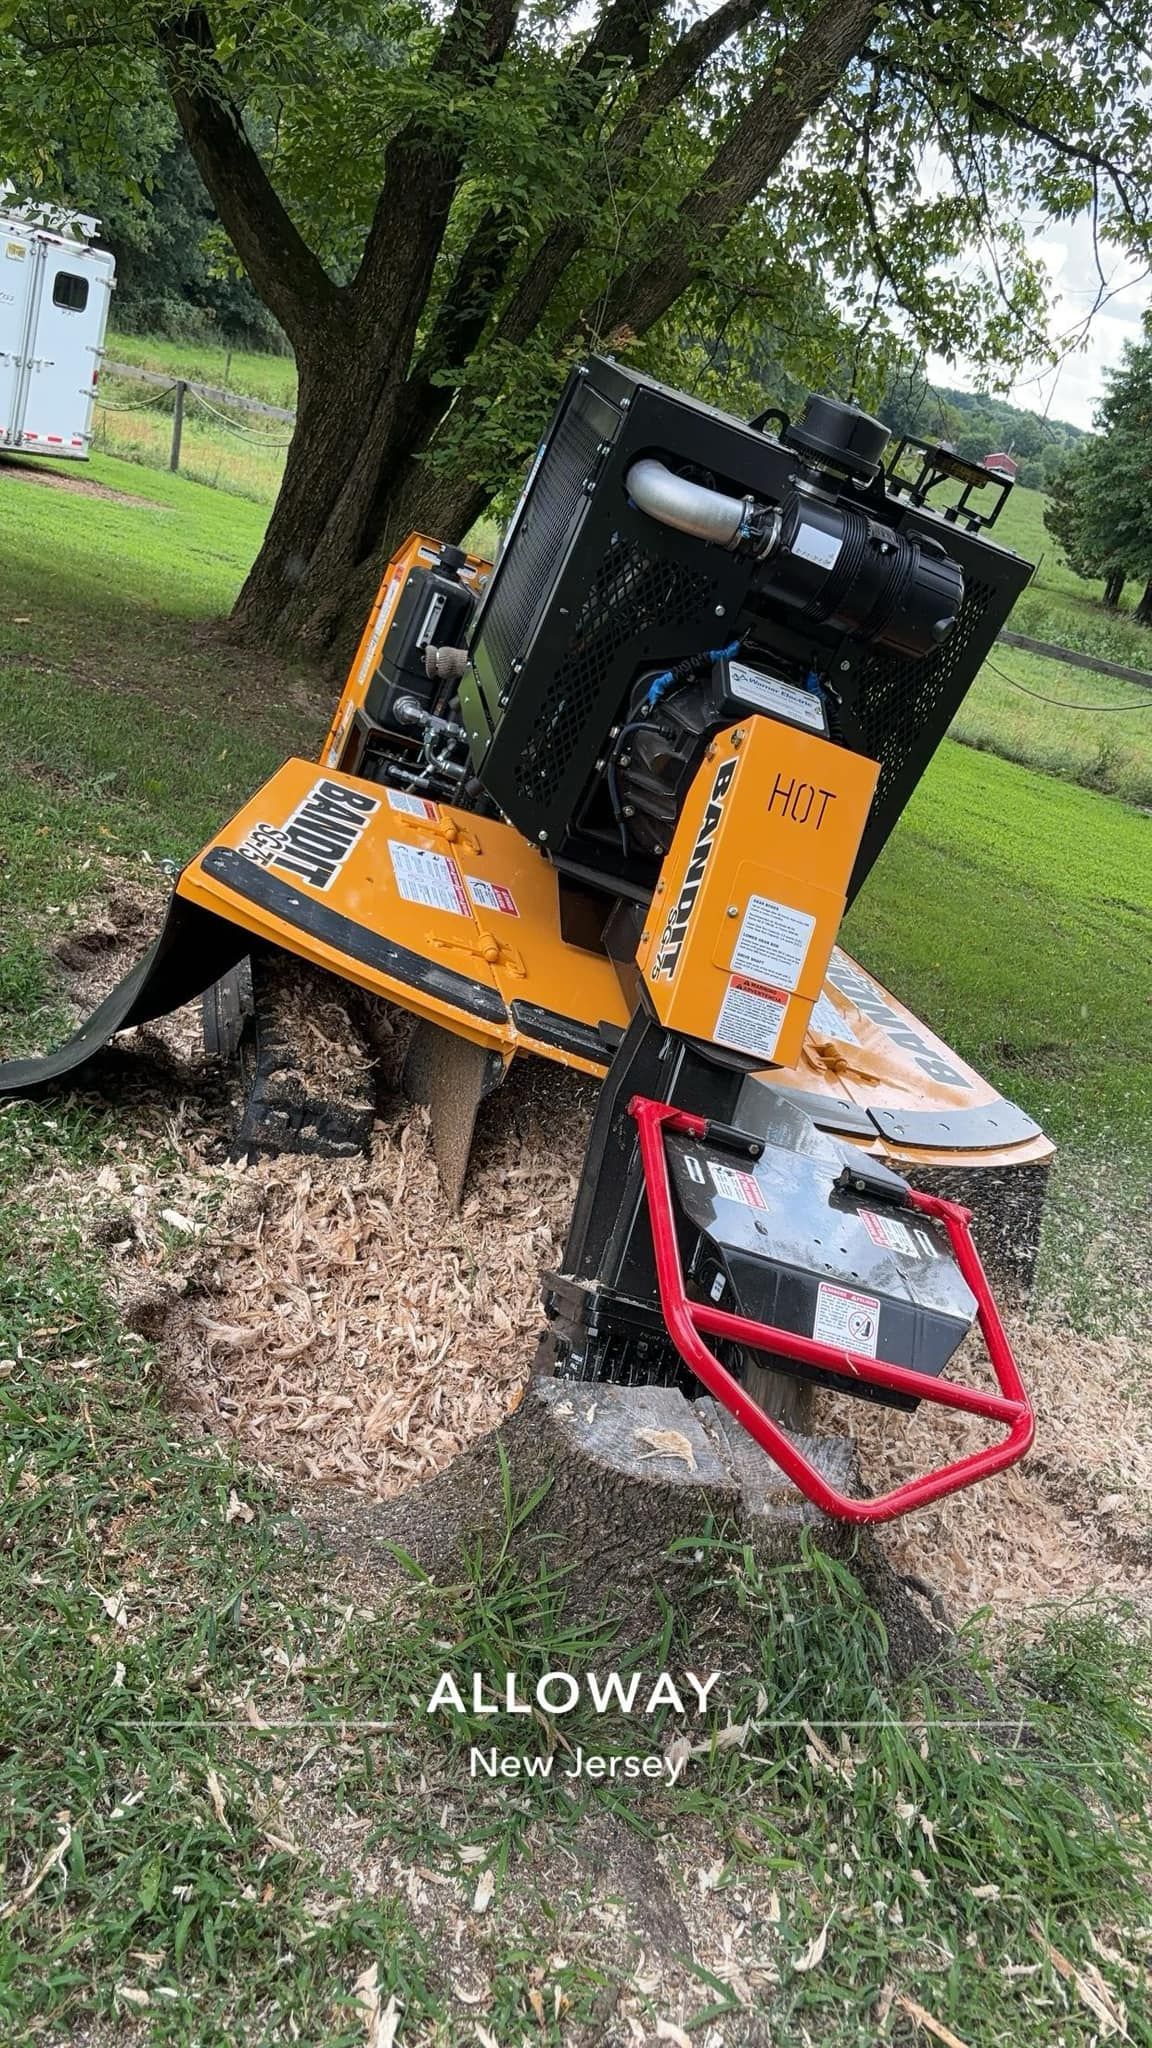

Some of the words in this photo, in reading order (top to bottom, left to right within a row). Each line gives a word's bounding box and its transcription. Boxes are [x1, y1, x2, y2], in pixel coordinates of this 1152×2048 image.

[749, 678, 779, 693] Warner
[273, 779, 378, 889] BANDIT
[767, 772, 838, 831] HOT
[238, 823, 289, 866] SG-75
[661, 757, 738, 978] BANDIT
[651, 907, 678, 980] SG-75
[827, 956, 974, 1089] BANDI
